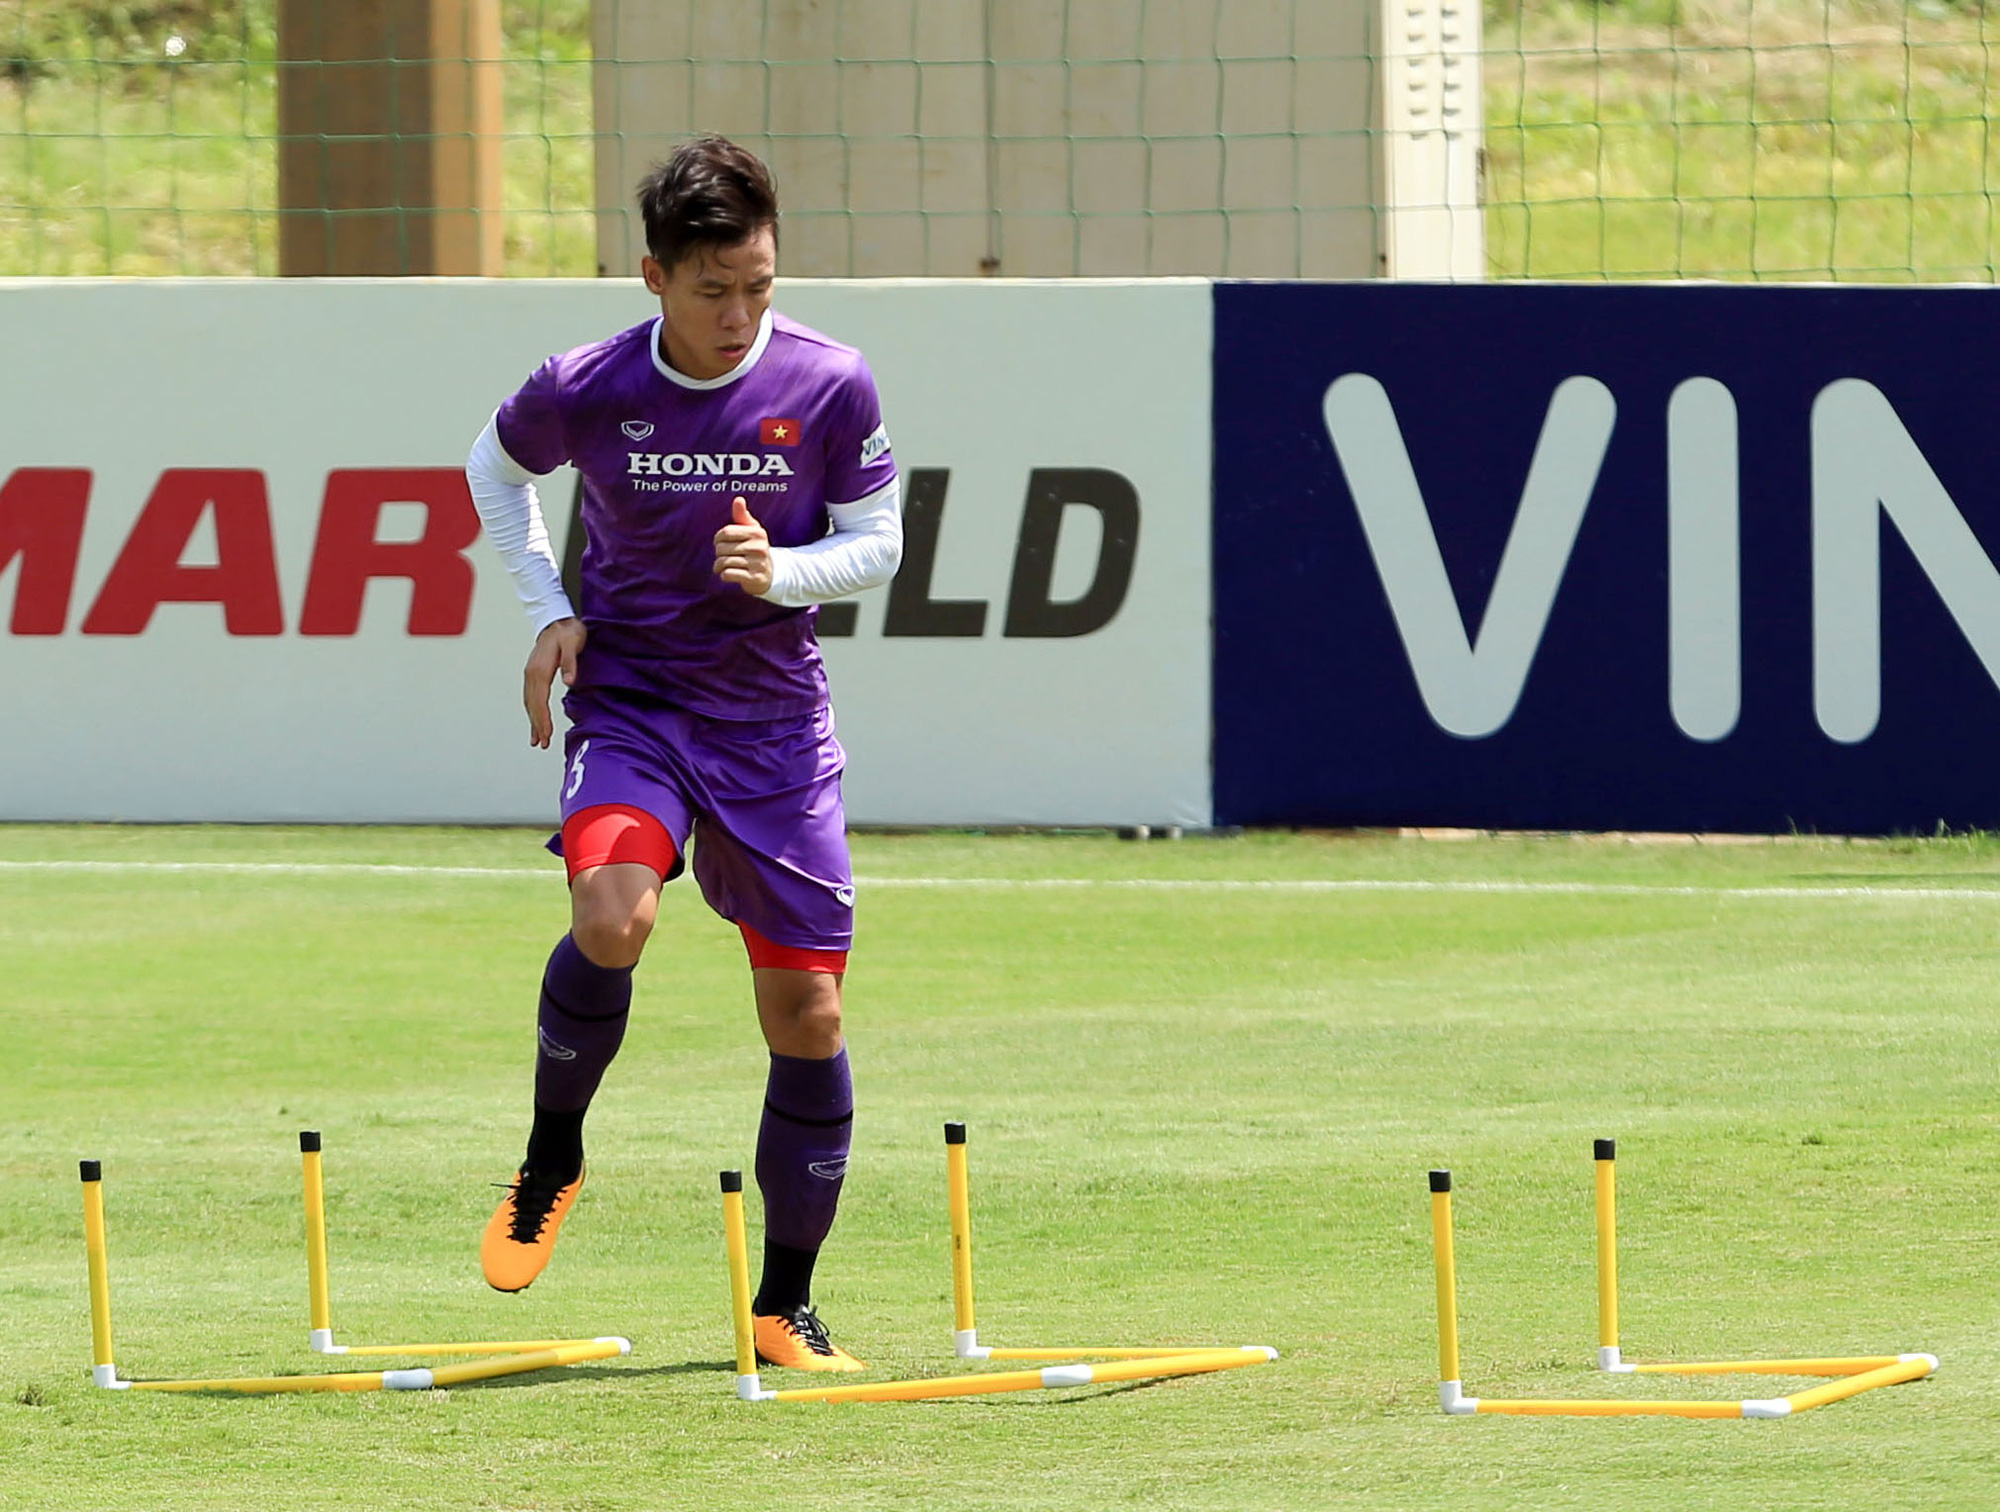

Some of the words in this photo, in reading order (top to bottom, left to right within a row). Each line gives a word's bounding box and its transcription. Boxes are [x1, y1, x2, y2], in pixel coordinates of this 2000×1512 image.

[627, 452, 795, 476] HONDA
[632, 479, 660, 491] The
[663, 480, 709, 492] Power
[712, 480, 728, 492] of
[731, 480, 788, 492] Dreams
[1322, 371, 2000, 744] VIN
